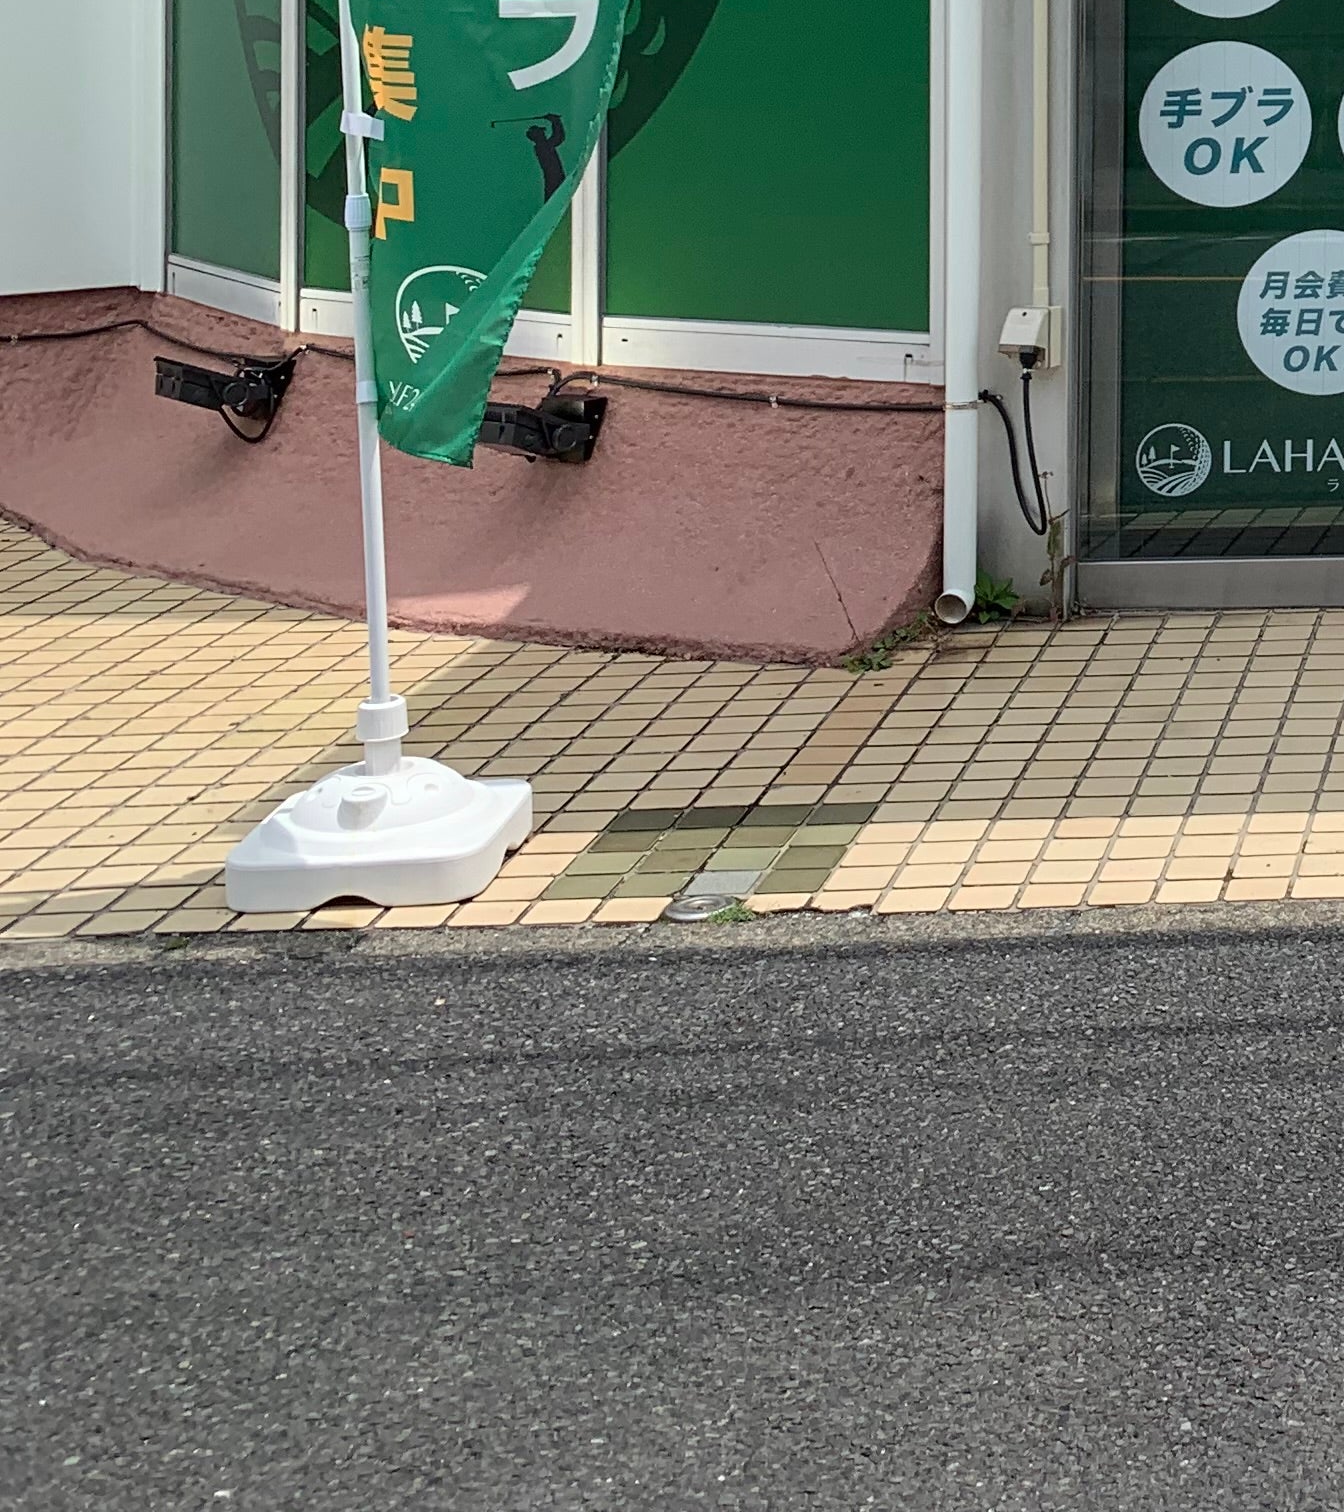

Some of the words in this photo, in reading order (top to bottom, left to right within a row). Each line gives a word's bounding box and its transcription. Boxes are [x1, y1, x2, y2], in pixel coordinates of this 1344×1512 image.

[1159, 86, 1296, 129] 手ブラ
[1183, 136, 1271, 175] OK
